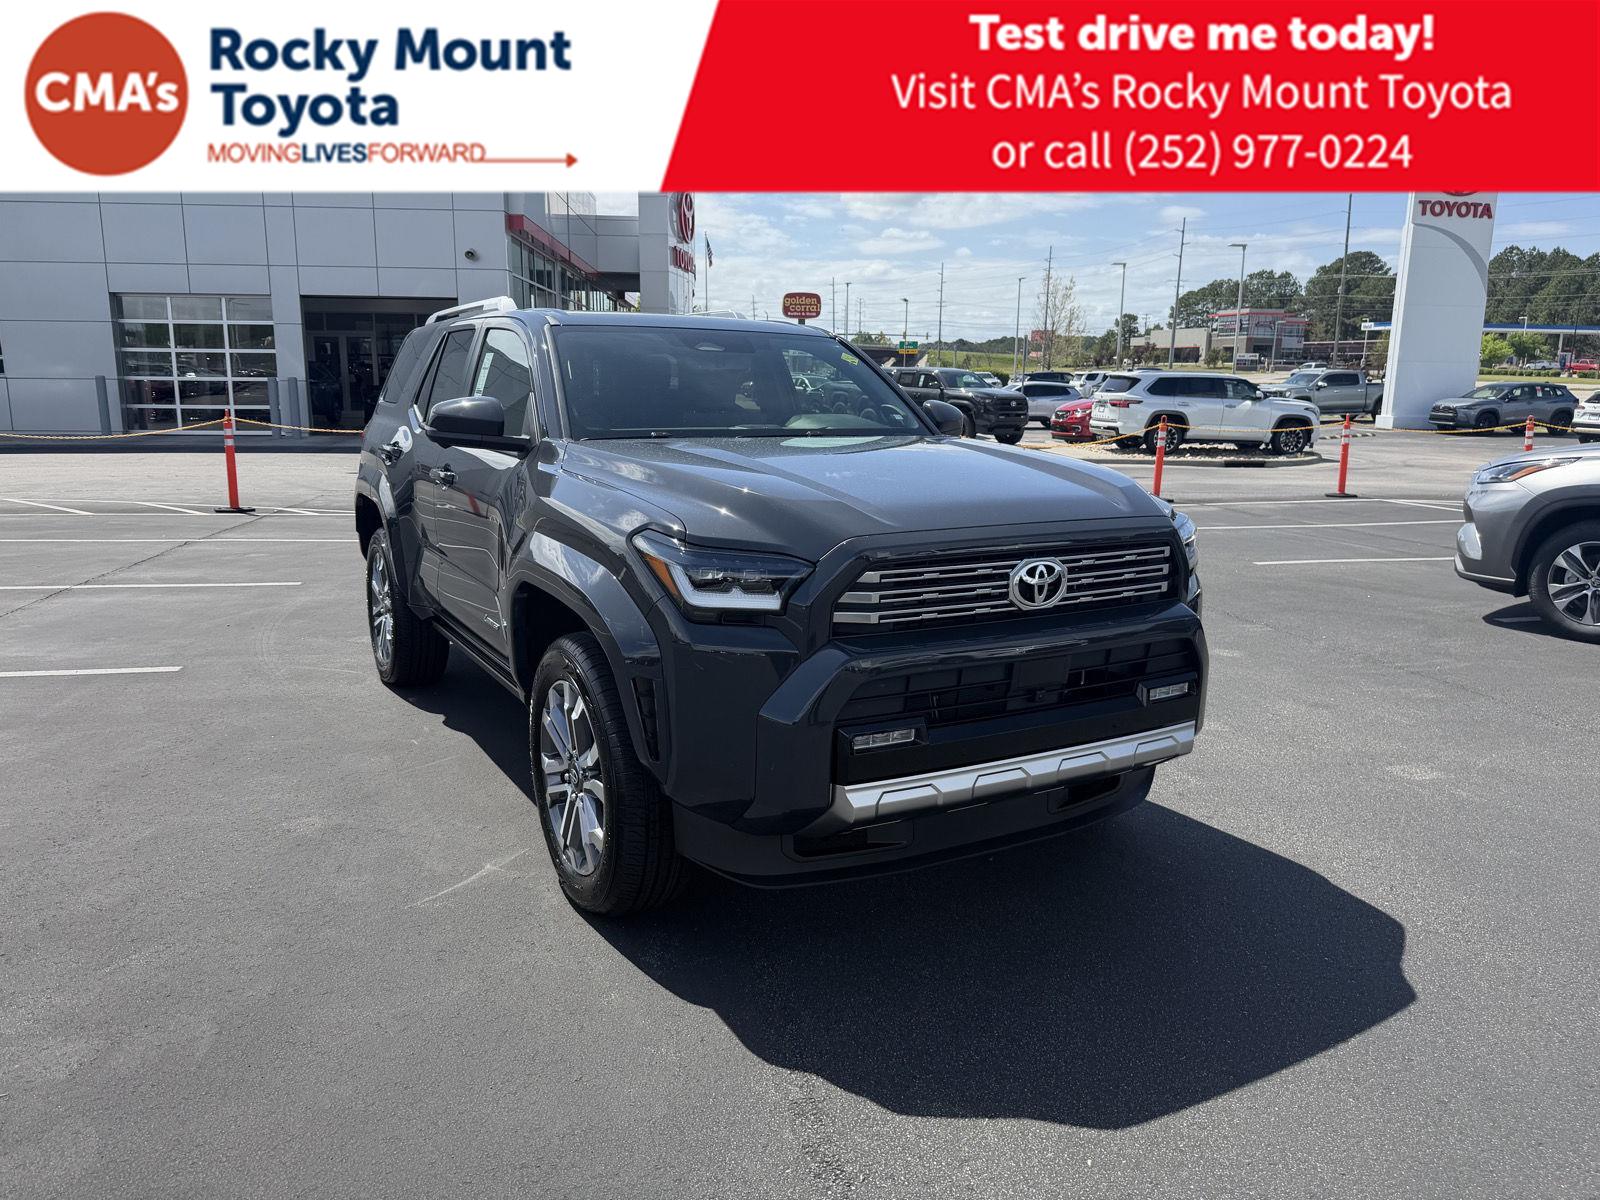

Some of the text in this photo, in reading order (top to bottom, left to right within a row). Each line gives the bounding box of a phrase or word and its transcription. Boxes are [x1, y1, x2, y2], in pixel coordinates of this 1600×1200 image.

[1418, 199, 1493, 219] TOYOTA
[784, 296, 817, 306] golden
[790, 303, 820, 312] corral
